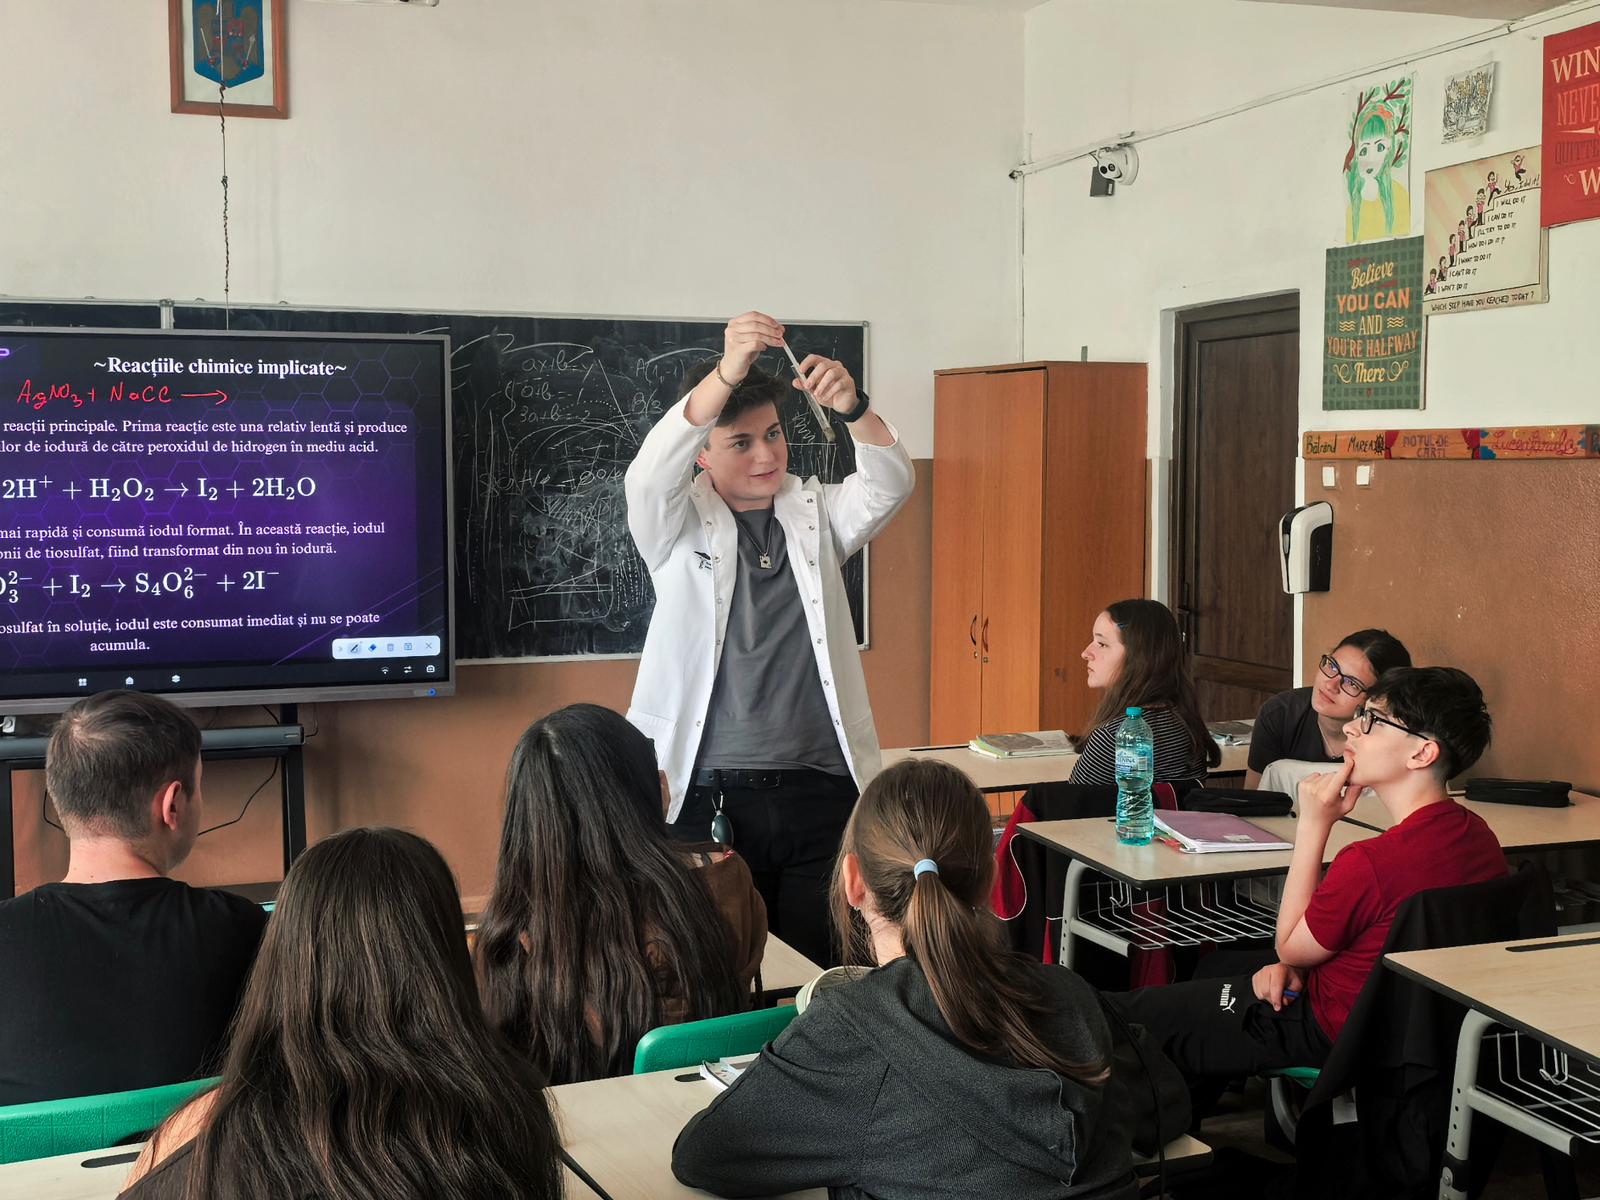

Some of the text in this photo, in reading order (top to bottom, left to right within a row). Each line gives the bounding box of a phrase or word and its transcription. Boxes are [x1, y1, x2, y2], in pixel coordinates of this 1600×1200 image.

[1351, 261, 1395, 290] Believe
[1336, 287, 1410, 314] YOU CAN
[1359, 314, 1383, 336] AND
[1327, 329, 1418, 359] YOU'RE HALFWAY
[188, 358, 254, 374] chimice
[1353, 361, 1387, 384] There
[3, 420, 408, 436] reacții principale. Prima reacție este una relativ lentă și produce
[24, 440, 40, 452] de
[44, 440, 88, 452] iodură
[92, 440, 109, 452] de
[112, 440, 144, 452] către
[148, 440, 209, 455] peroxidul
[212, 440, 228, 452] de
[231, 440, 288, 454] hidrogen
[290, 440, 303, 452] în
[306, 440, 346, 452] mediu
[349, 441, 379, 452] acid.
[25, 526, 68, 542] rapidă
[72, 526, 83, 540] și
[86, 525, 146, 538] consumă
[149, 524, 183, 537] iodul
[186, 524, 234, 537] format.
[238, 521, 252, 536] În
[255, 522, 302, 536] această
[305, 522, 350, 538] reacție,
[353, 522, 385, 534] iodul
[25, 547, 41, 559] de
[45, 546, 104, 560] tiosulfat,
[108, 545, 139, 558] fiind
[142, 544, 219, 557] transformat
[222, 544, 244, 556] din
[247, 546, 272, 556] nou
[276, 542, 288, 555] în
[292, 542, 337, 554] iodură.
[48, 620, 60, 633] în
[64, 618, 112, 634] soluție,
[115, 618, 150, 631] iodul
[153, 620, 178, 630] este
[181, 617, 244, 629] consumat
[246, 614, 294, 627] imediat
[298, 613, 308, 628] și
[310, 615, 326, 625] nu
[330, 615, 342, 625] se
[346, 614, 380, 628] poate
[90, 638, 151, 652] acumula.
